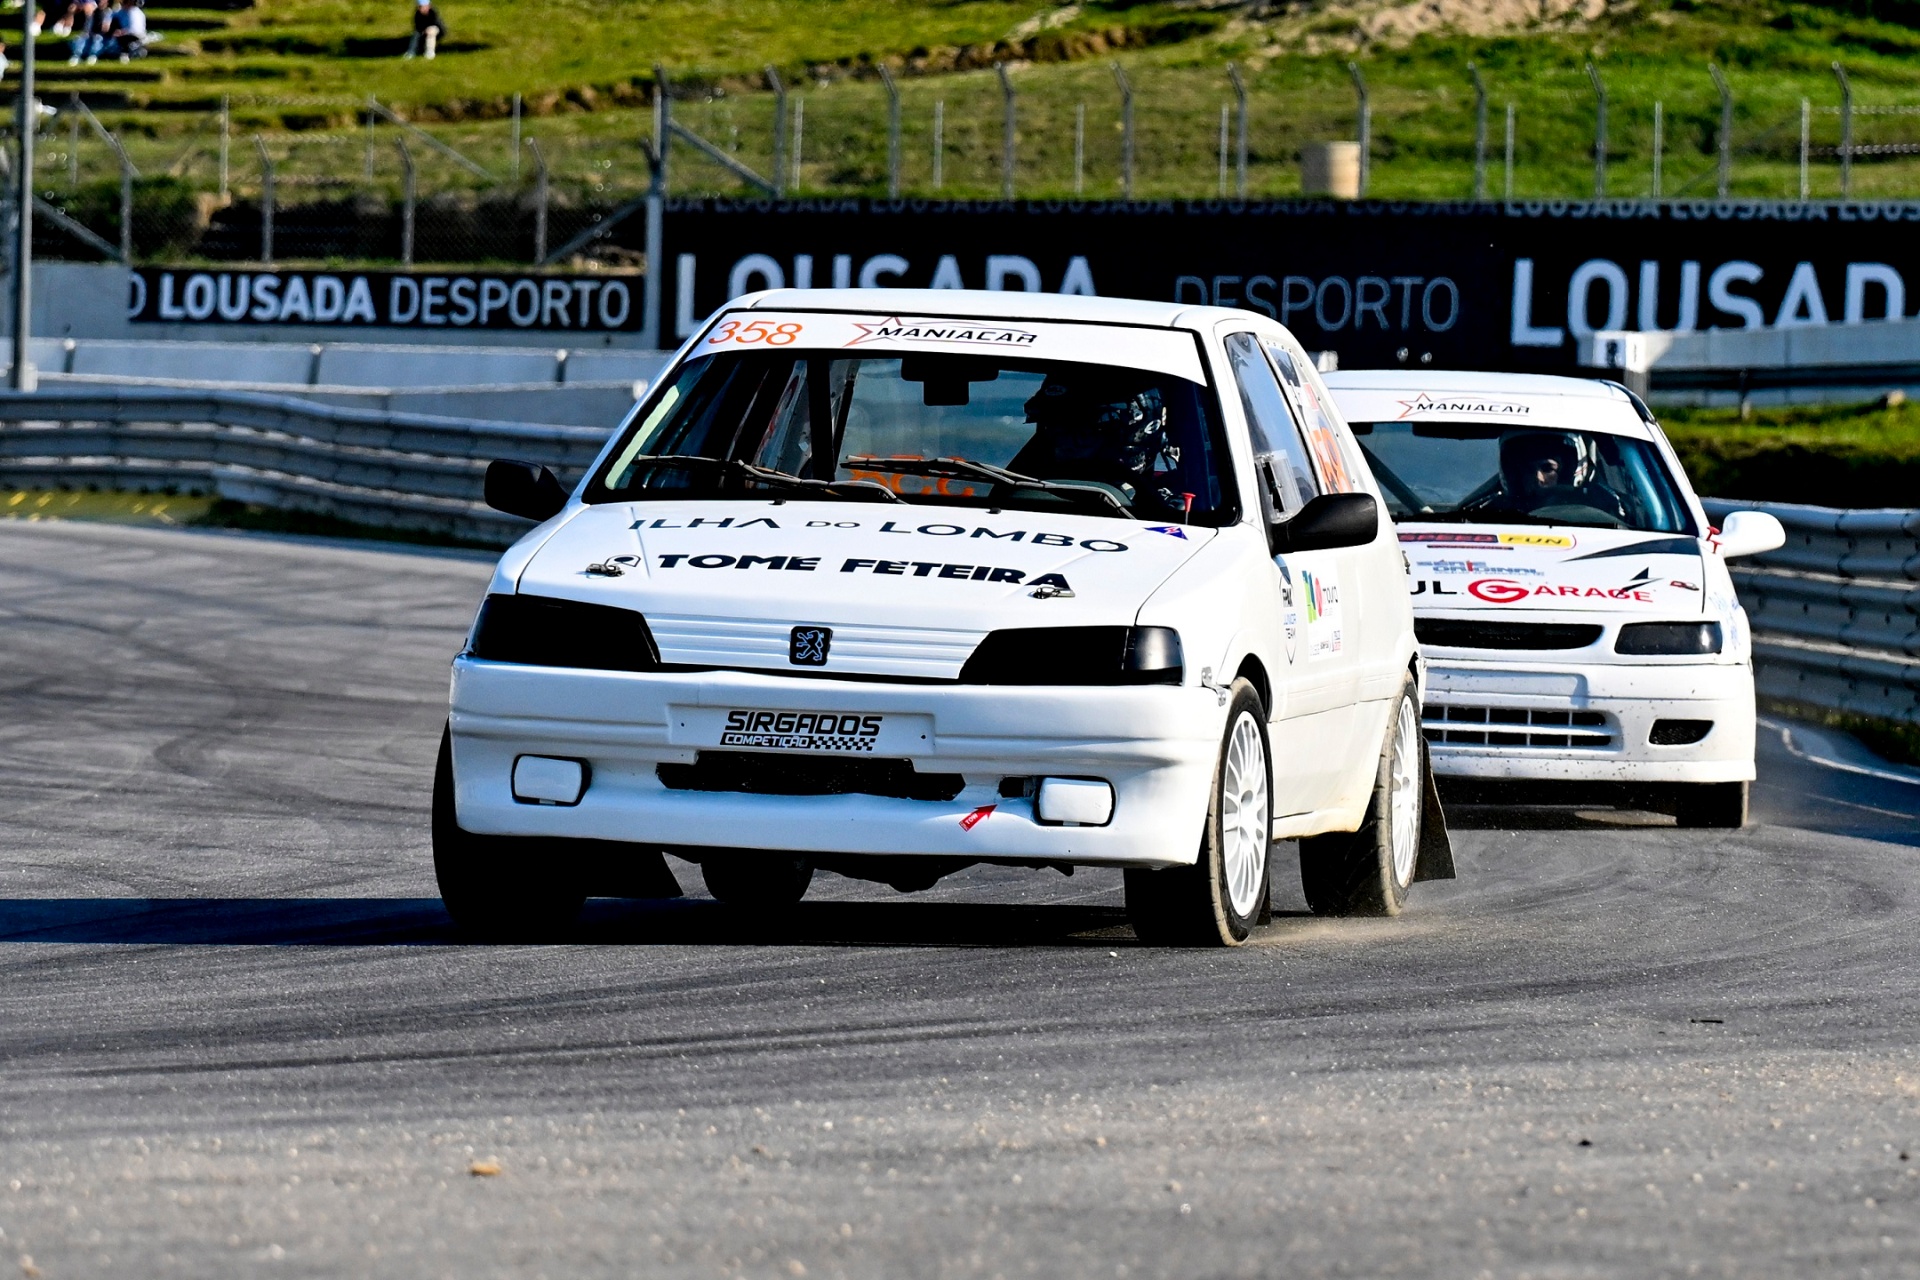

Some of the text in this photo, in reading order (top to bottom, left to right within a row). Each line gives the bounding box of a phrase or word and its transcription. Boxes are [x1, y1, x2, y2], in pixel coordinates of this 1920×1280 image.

[160, 273, 376, 322] LOUSADA
[390, 277, 630, 328] DESPORTO
[1174, 275, 1460, 333] DESPORTO
[1511, 257, 1920, 346] LOUSAD
[709, 320, 804, 346] 358
[877, 326, 1038, 345] MANIACAR
[1416, 402, 1530, 414] MANIACAR
[628, 517, 1129, 553] ILHA DO LOMBO
[1507, 536, 1563, 545] FUN
[1468, 578, 1654, 603] GARAGE
[725, 711, 883, 737] SIRGADOS
[964, 813, 979, 825] TOW
